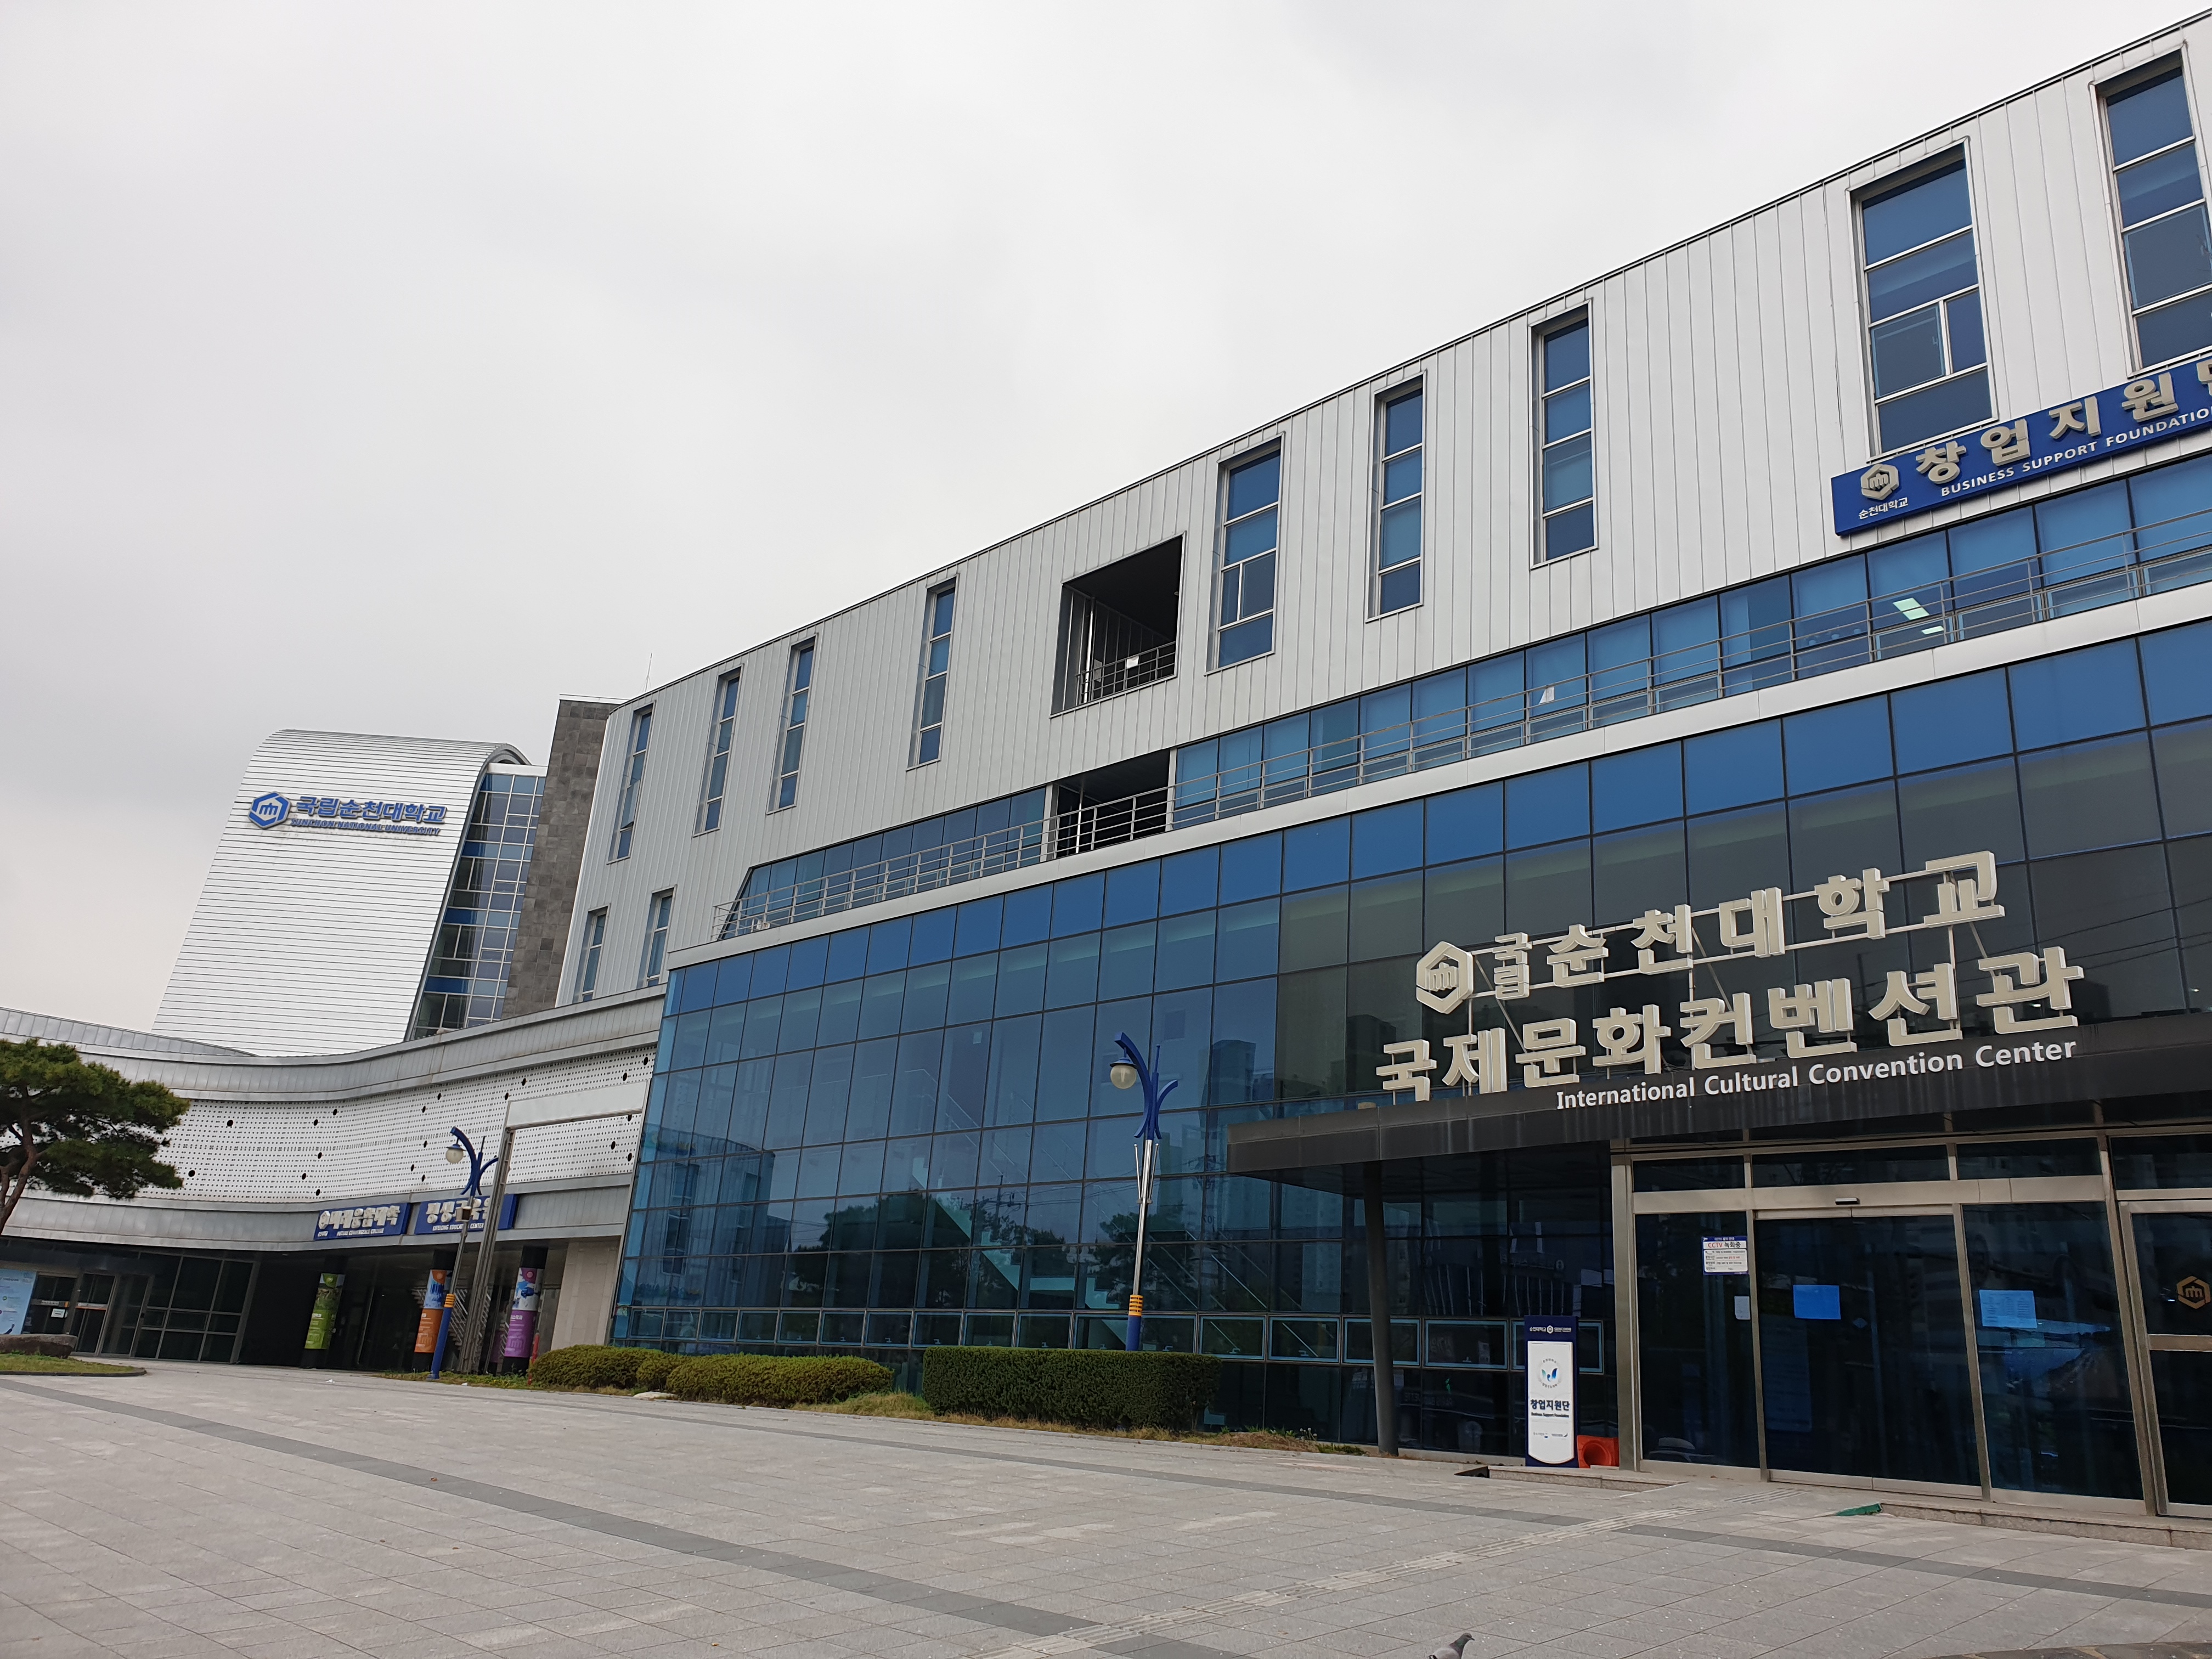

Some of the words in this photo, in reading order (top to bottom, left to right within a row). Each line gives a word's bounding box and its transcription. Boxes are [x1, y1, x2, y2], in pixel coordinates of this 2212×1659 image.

[1941, 467, 2015, 496] BUSINESS
[2022, 442, 2096, 473] SUPPORT
[2106, 407, 2212, 448] FOUNDATIO
[1858, 496, 1909, 520] 순천대학교
[296, 795, 447, 823] 국립순천대학교
[291, 818, 335, 828] SUNCHON
[337, 821, 382, 832] NATIONAL
[385, 825, 441, 836] UNIVERSITY
[1546, 850, 2005, 988] 순천대학교
[1556, 1077, 1695, 1110] International
[1703, 1068, 1799, 1097] Cultural
[1812, 1052, 1963, 1087] Convention
[1975, 1037, 2077, 1069] Center
[1530, 1399, 1570, 1411] 창업지원단
